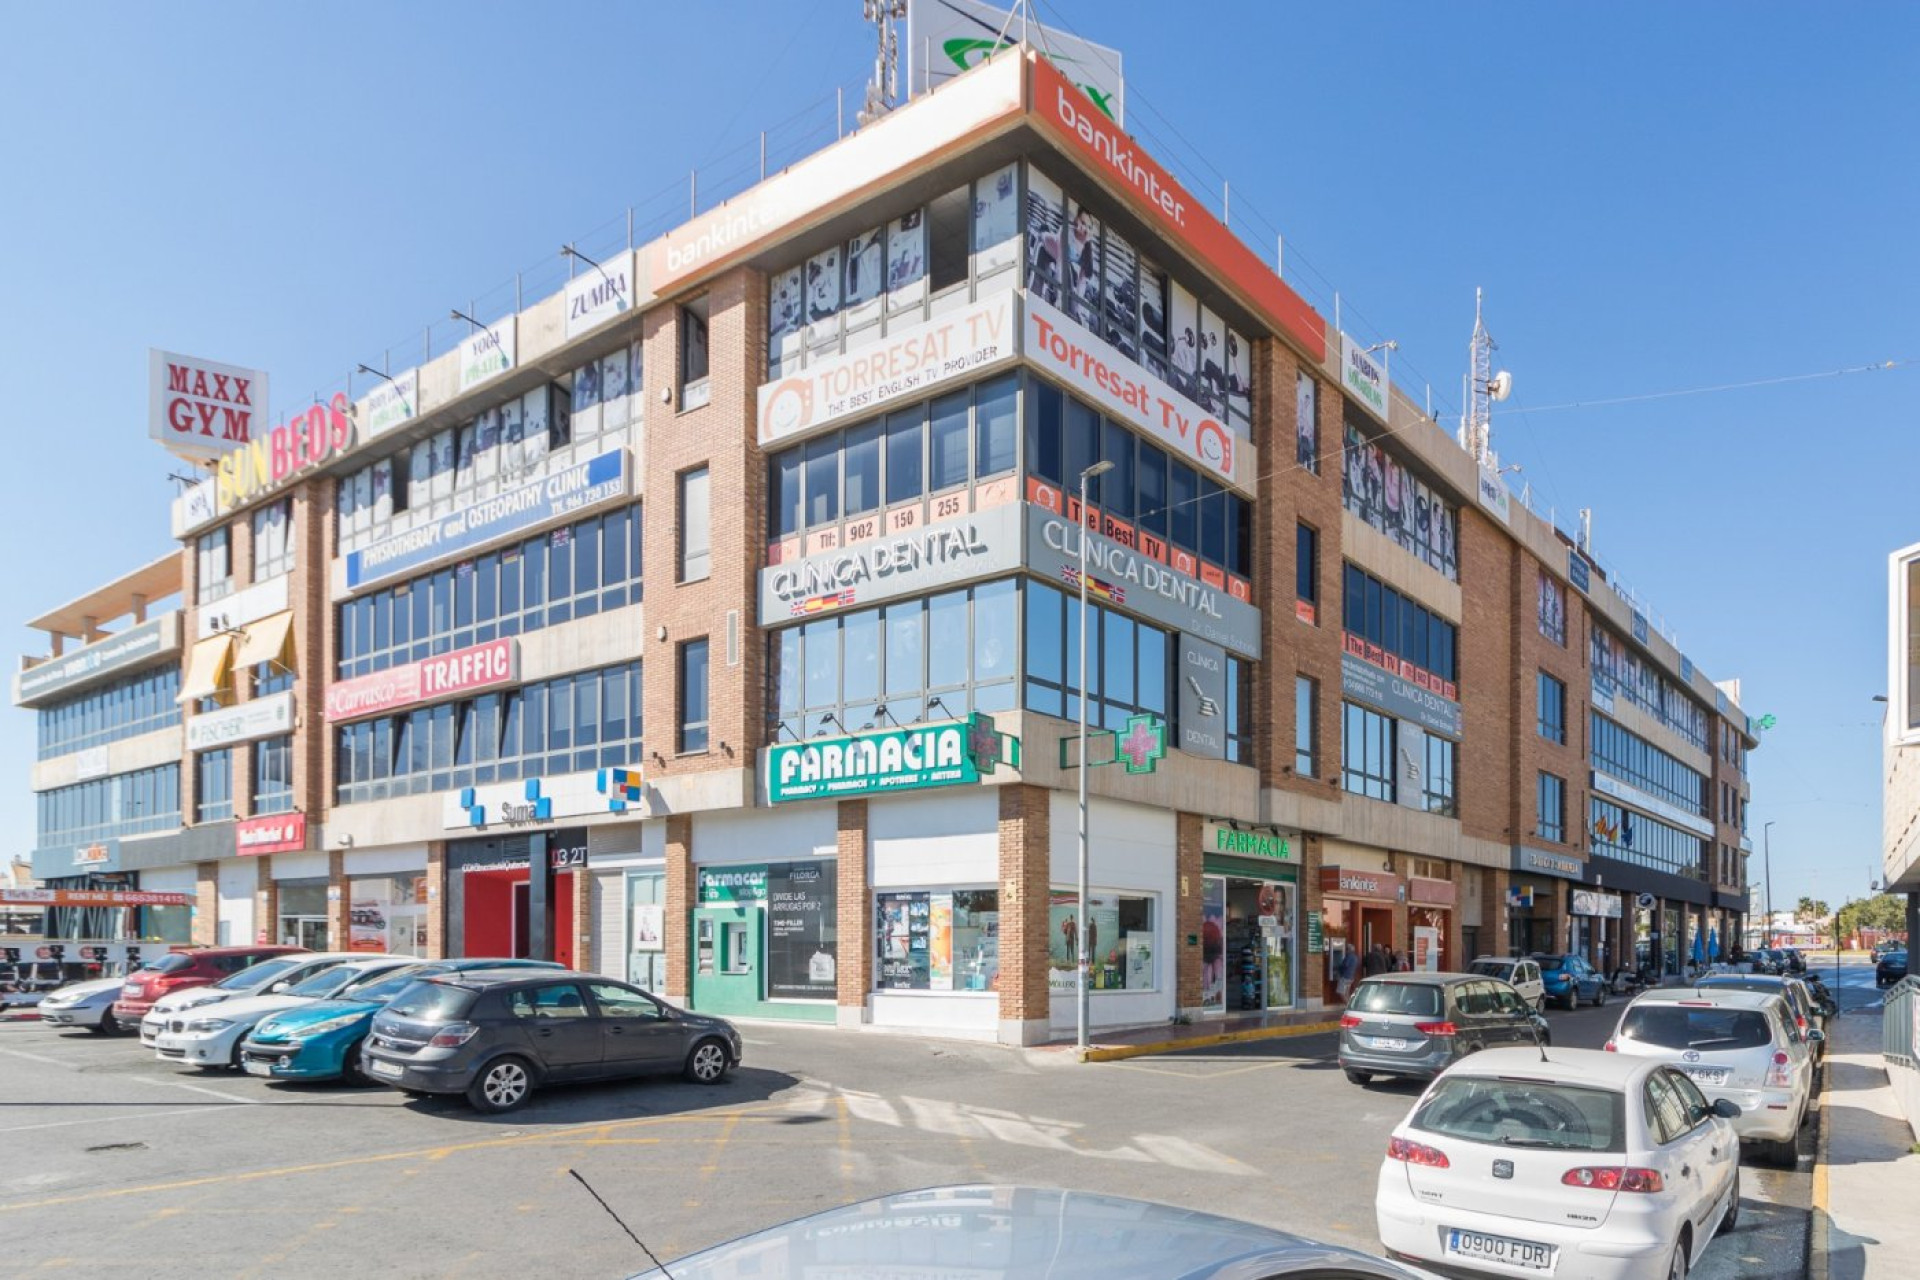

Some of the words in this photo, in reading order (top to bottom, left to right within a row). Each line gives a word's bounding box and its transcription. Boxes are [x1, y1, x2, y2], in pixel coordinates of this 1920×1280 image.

[1057, 85, 1186, 227] bankinter.
[570, 272, 627, 321] ZUMBA
[820, 323, 955, 401] TORRESAT
[965, 305, 1006, 347] TV
[1031, 312, 1150, 417] Torresat
[1156, 397, 1190, 440] Tv
[167, 362, 252, 407] MAXX
[827, 400, 845, 417] THE
[850, 390, 874, 408] BEST
[878, 374, 919, 399] ENGLISH
[926, 366, 940, 381] TV
[943, 345, 998, 374] PROVIDER
[168, 397, 253, 444] GYM
[362, 522, 441, 569] PHYSIOTHERAPY
[443, 516, 467, 538] and
[468, 485, 544, 528] OSTEOPATHY
[547, 464, 590, 499] CLINIC
[820, 533, 836, 549] Tlf:
[850, 521, 873, 542] 902
[894, 510, 914, 529] 150
[937, 497, 960, 518] 255
[1072, 501, 1096, 529] Te
[1106, 518, 1134, 546] Best
[1145, 537, 1161, 558] TV
[872, 524, 984, 574] DENTAL
[1042, 520, 1140, 584] CLNICA
[1142, 563, 1223, 619] DENTAL
[423, 645, 507, 692] TRAFFIC
[780, 729, 962, 785] FARMACIA
[1186, 729, 1219, 749] DENTAL
[501, 801, 536, 824] Suma
[1217, 829, 1290, 859] FARMACIA
[794, 892, 806, 901] LAS
[1340, 875, 1378, 892] ankinter
[1461, 1234, 1505, 1256] 0900
[1510, 1242, 1545, 1263] FDR
